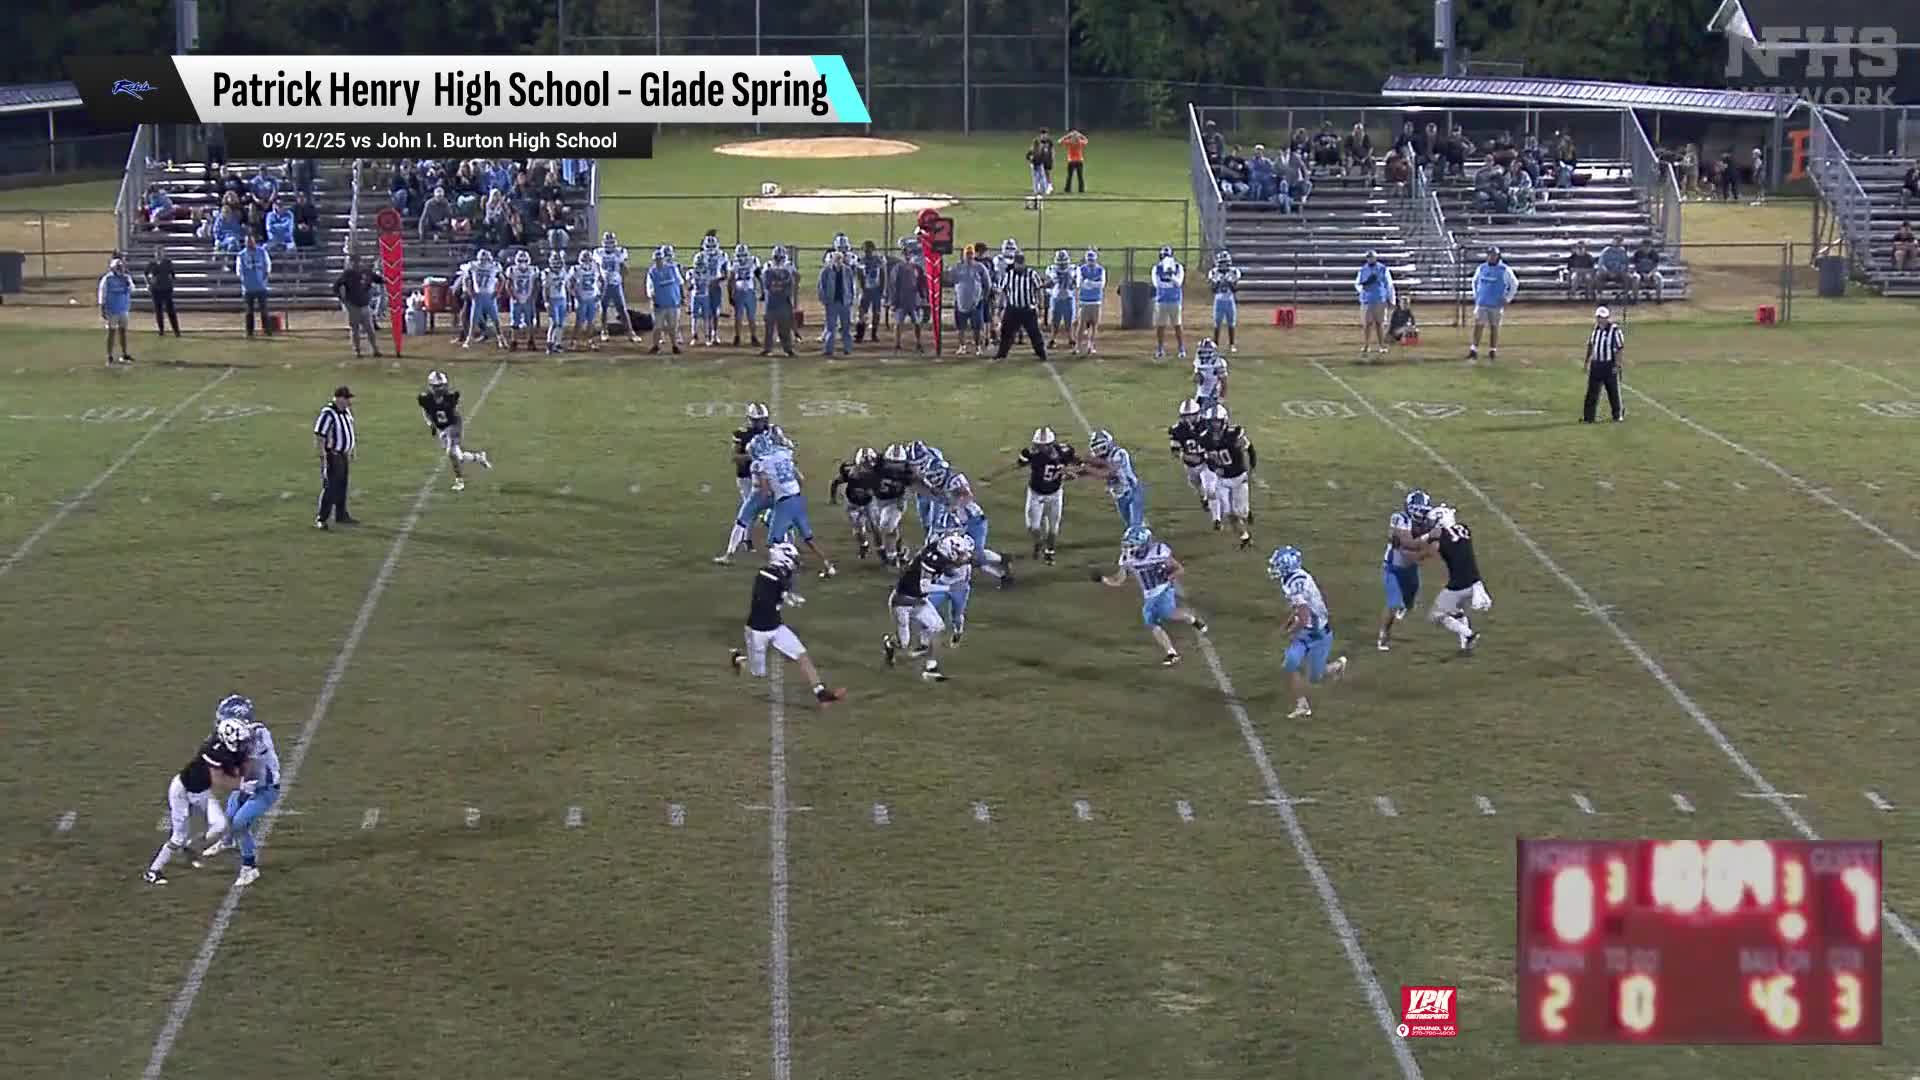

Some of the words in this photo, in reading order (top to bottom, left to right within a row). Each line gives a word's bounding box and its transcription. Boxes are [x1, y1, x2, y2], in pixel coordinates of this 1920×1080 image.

[1542, 973, 1572, 1031] 2
[1620, 974, 1656, 1031] 0
[1750, 974, 1800, 1031] 46
[1836, 974, 1862, 1031] 3
